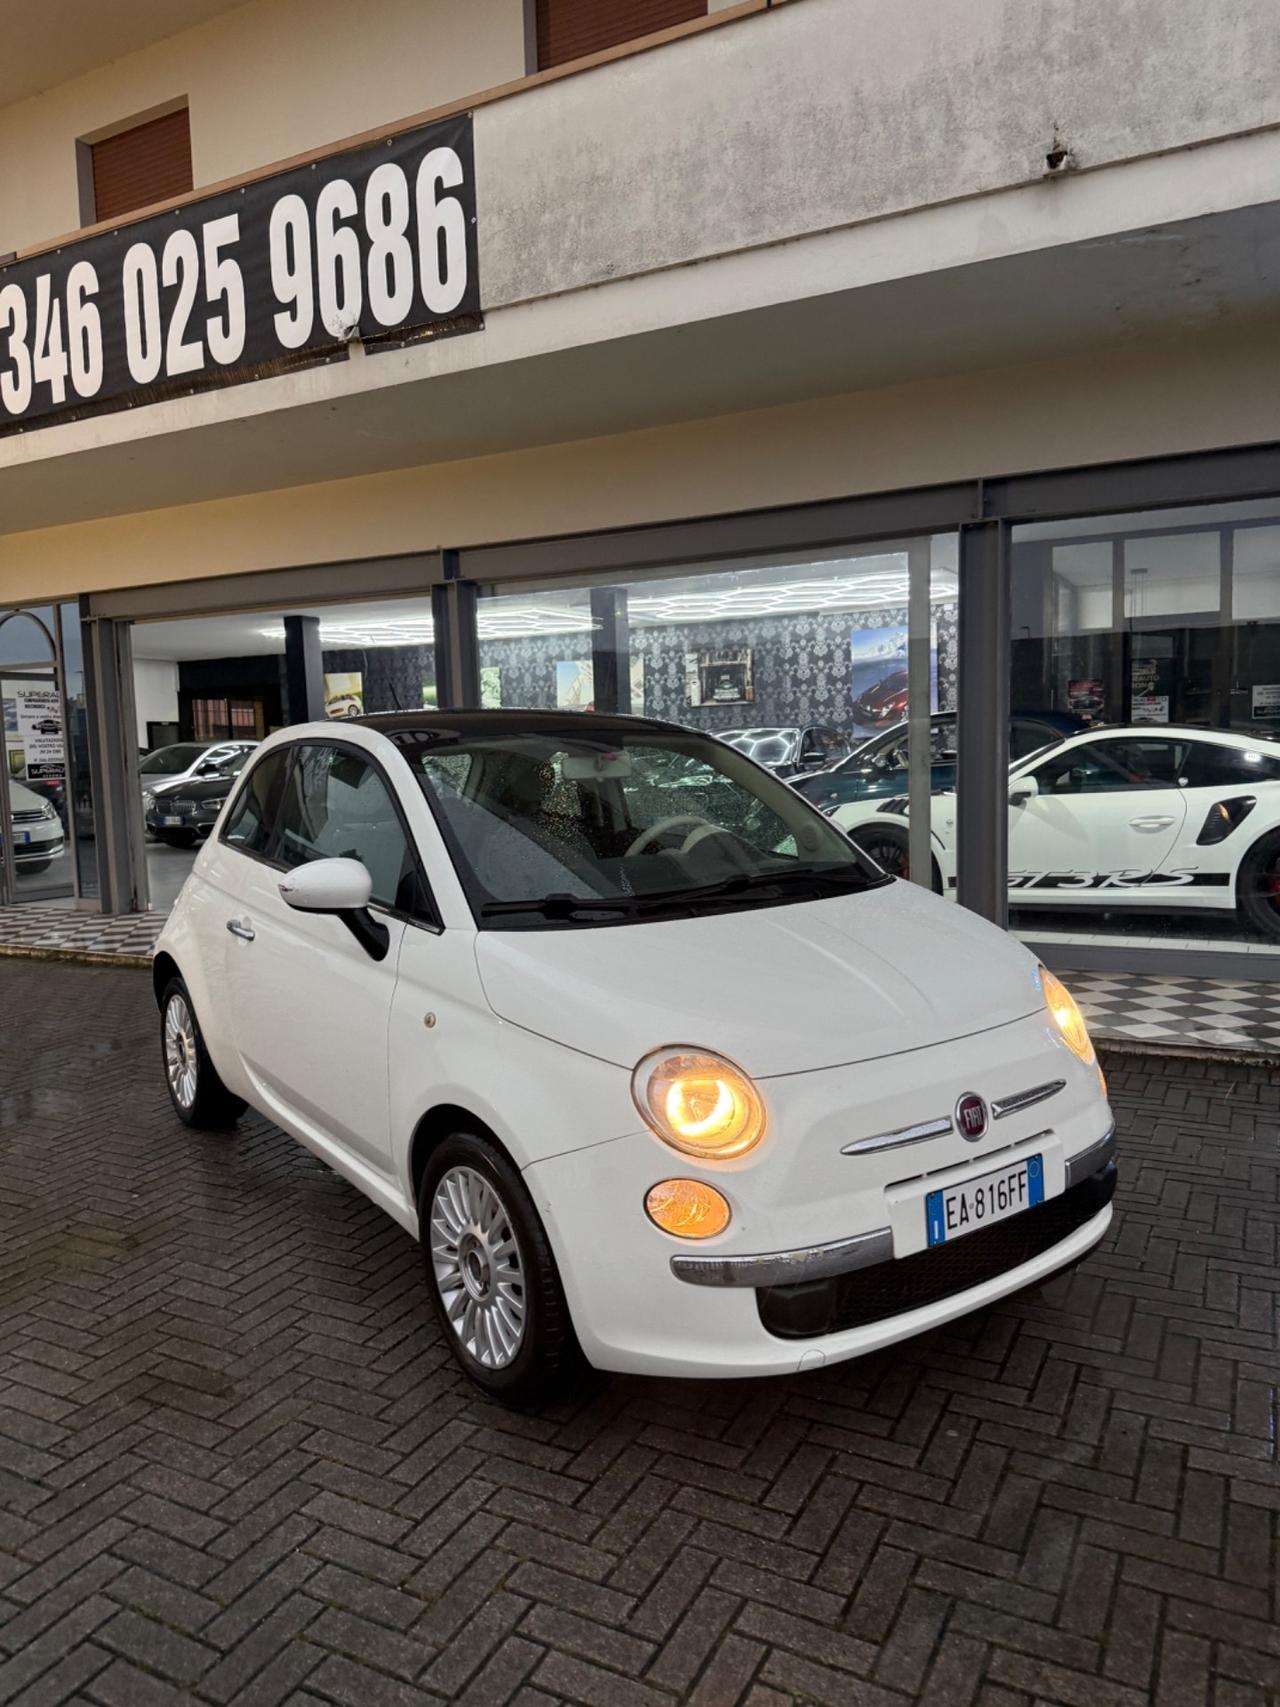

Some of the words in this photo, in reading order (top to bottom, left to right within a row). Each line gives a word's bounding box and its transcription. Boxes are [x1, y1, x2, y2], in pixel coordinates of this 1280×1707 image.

[0, 261, 103, 415] 346
[123, 213, 246, 384] 025
[269, 147, 467, 349] 9686
[964, 1107, 983, 1129] FIAT
